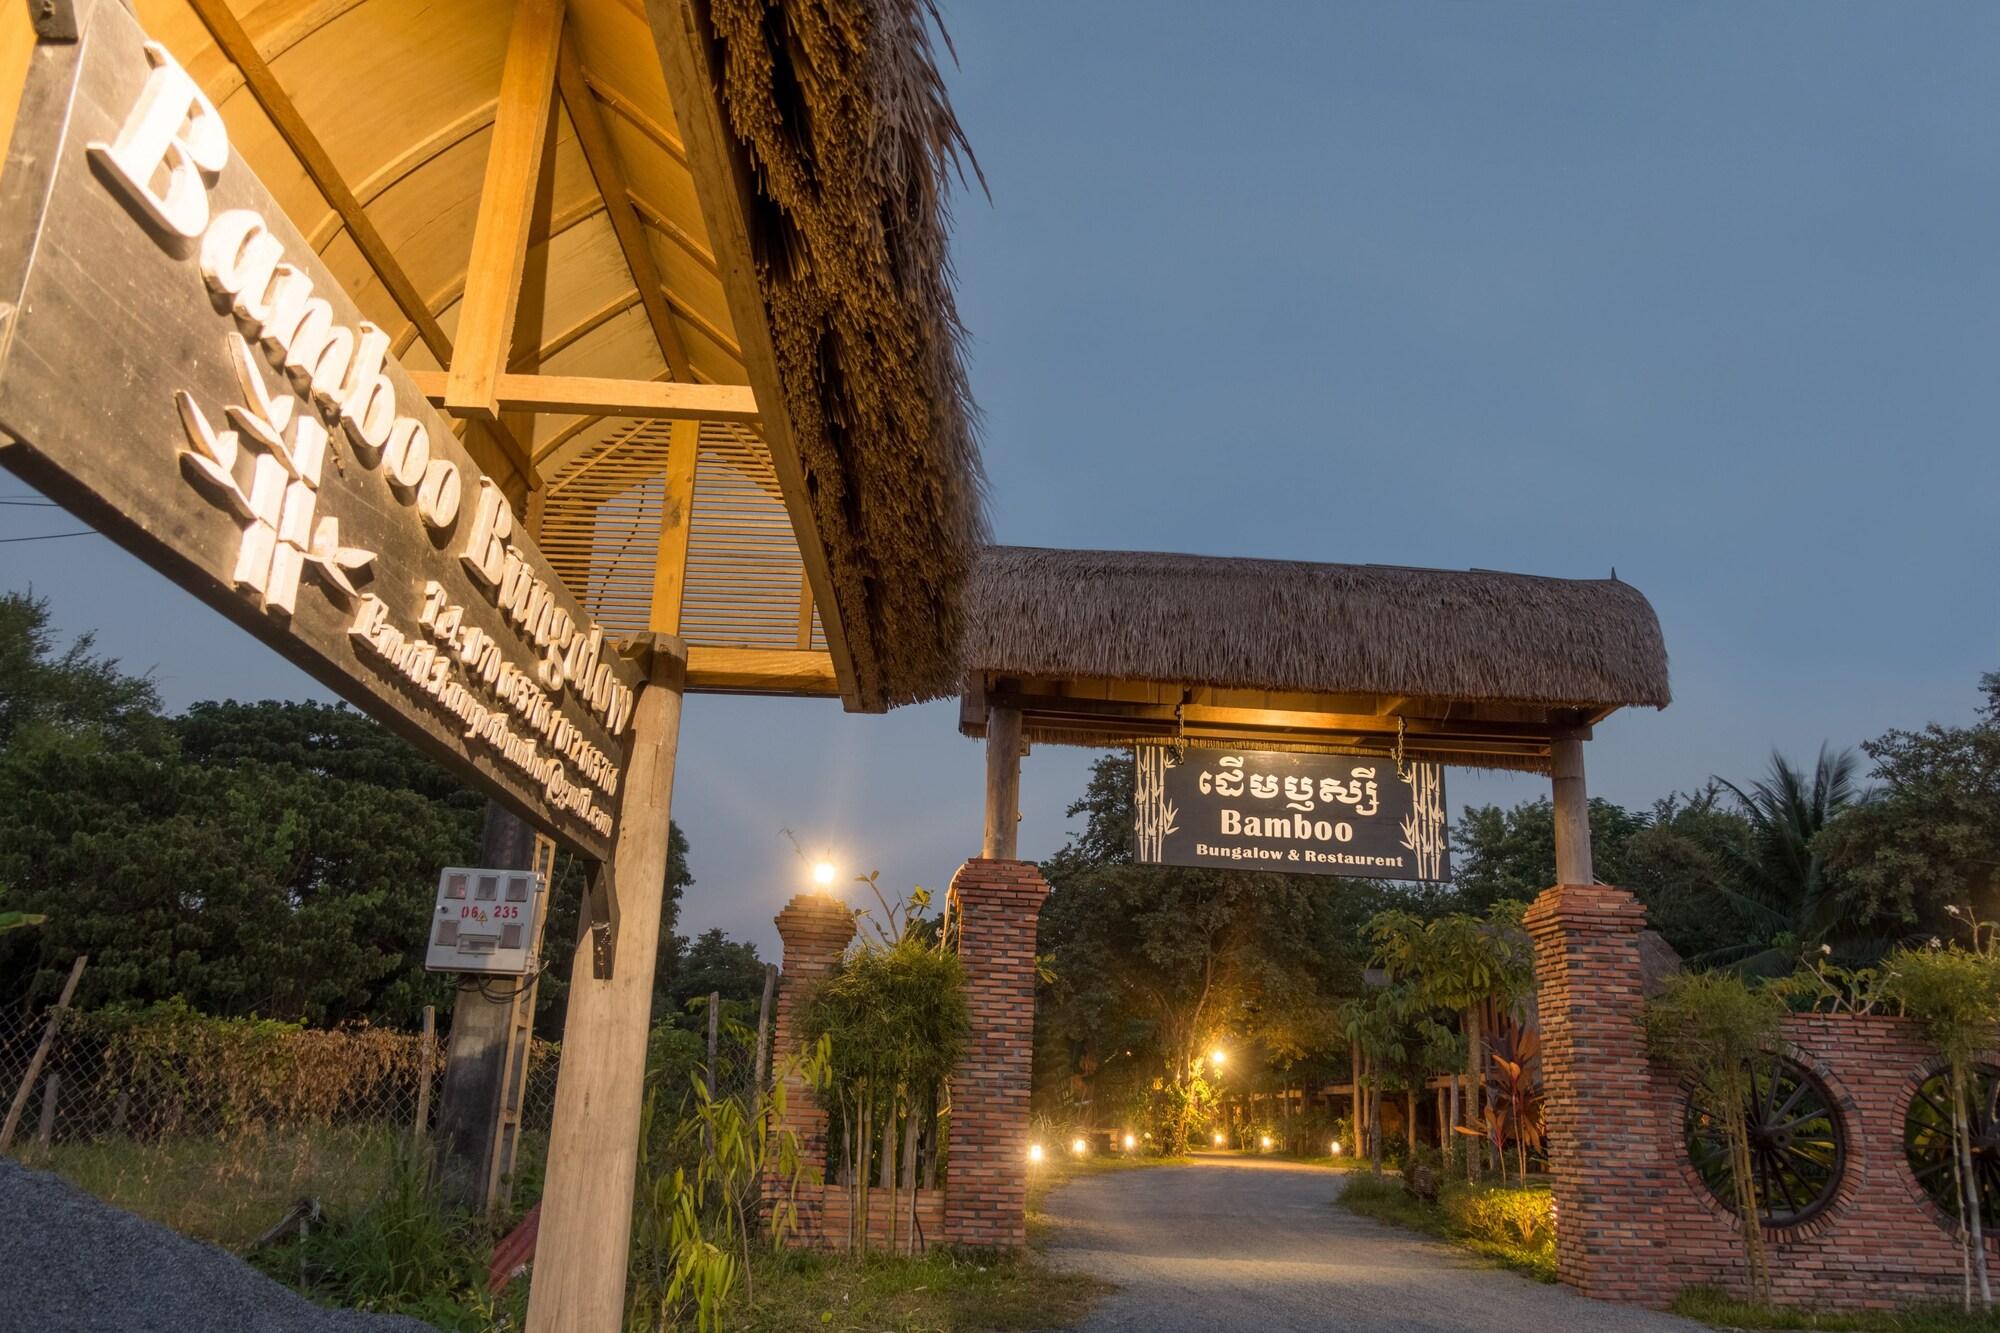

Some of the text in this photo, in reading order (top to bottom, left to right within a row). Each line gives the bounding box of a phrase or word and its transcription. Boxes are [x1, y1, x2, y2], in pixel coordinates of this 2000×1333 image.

[86, 40, 634, 736] Bamboo Bungalow
[1220, 809, 1353, 842] Bamboo
[1196, 843, 1404, 867] Bungalow & Restaurent
[494, 905, 518, 918] 235
